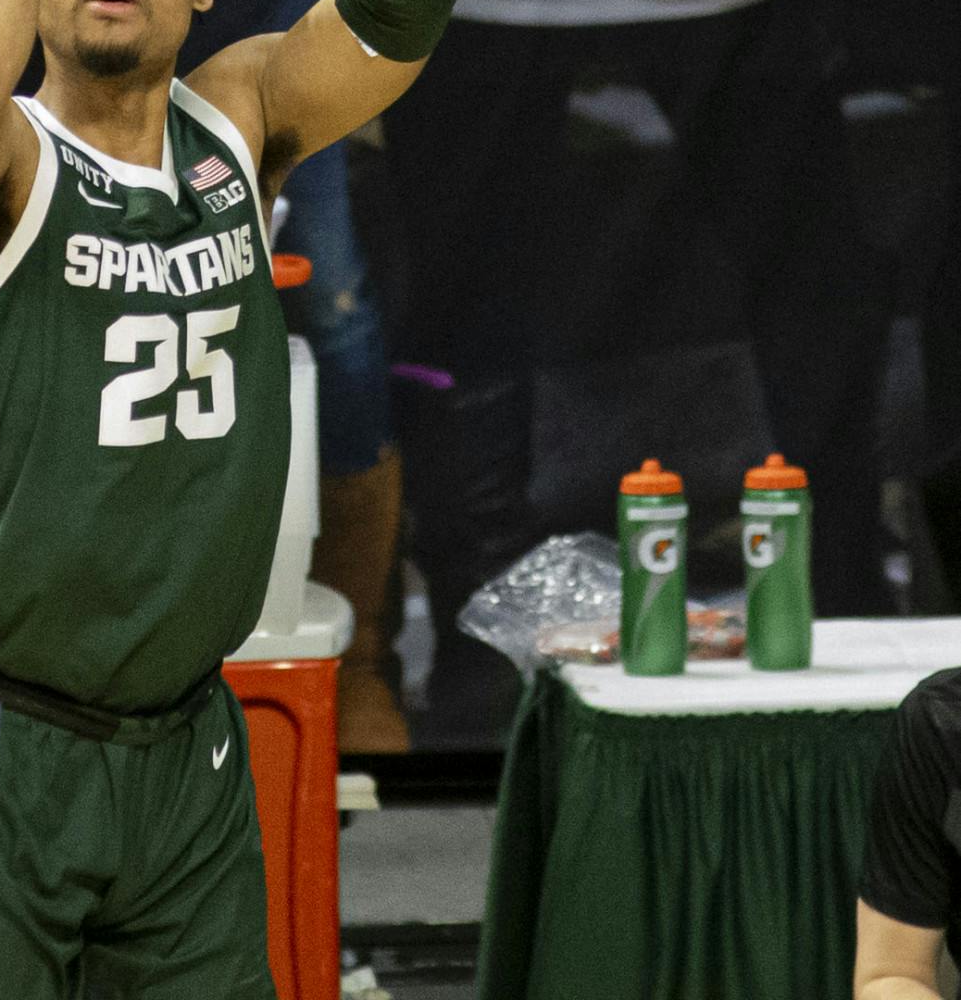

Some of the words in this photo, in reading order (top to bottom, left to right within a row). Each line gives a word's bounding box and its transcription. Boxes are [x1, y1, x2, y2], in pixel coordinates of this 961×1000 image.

[60, 145, 113, 194] UNITY
[64, 223, 255, 297] SPARTANS
[98, 304, 240, 446] 25
[638, 528, 678, 574] G
[743, 523, 775, 569] G
